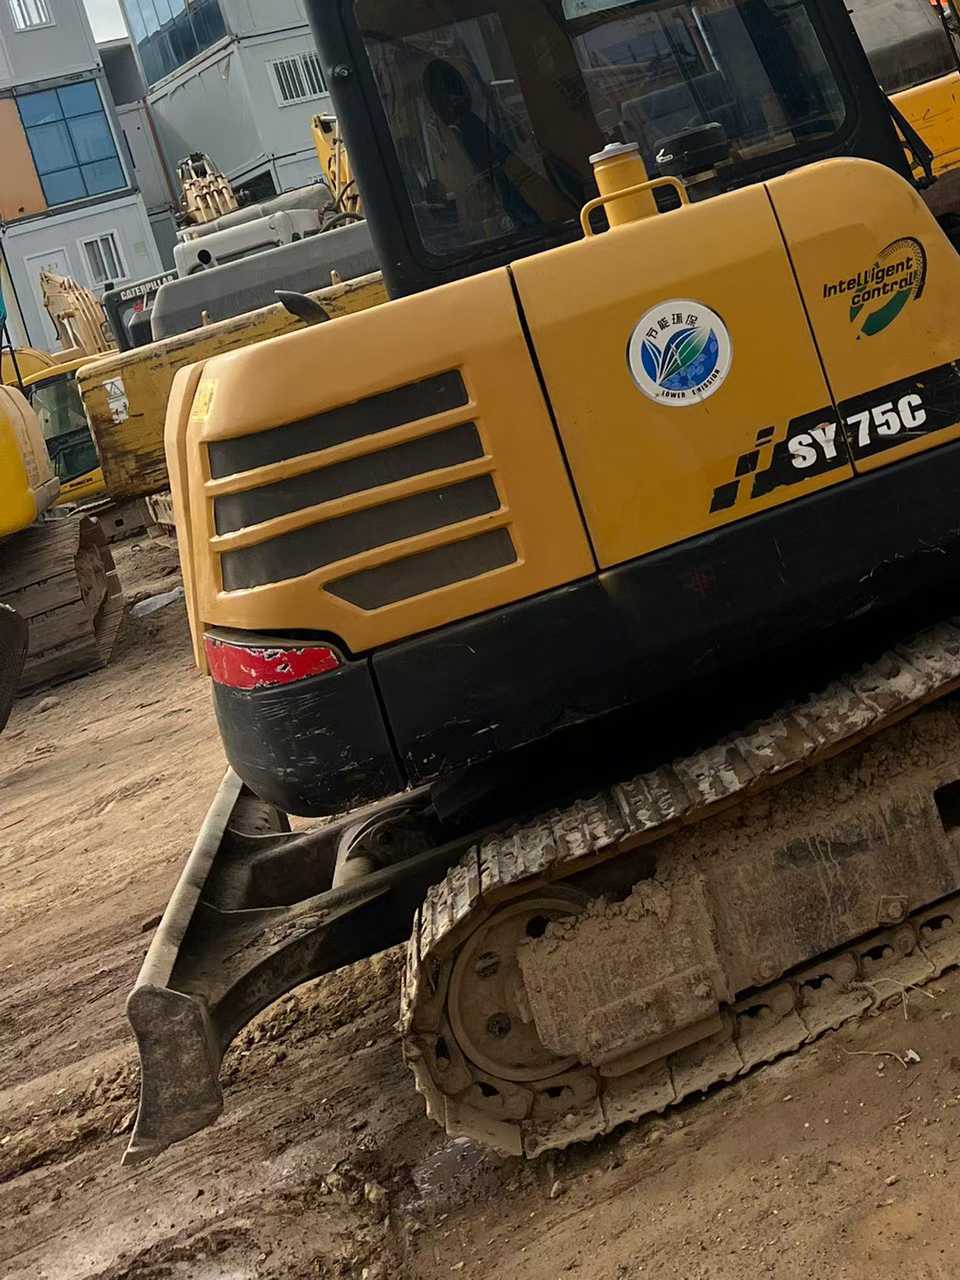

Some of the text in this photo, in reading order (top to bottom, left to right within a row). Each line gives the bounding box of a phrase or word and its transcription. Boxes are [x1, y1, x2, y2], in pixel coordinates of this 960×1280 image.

[120, 275, 174, 301] CATERPILLAR
[823, 256, 914, 299] Intelligent
[851, 271, 915, 307] control
[787, 393, 928, 469] SY 75C
